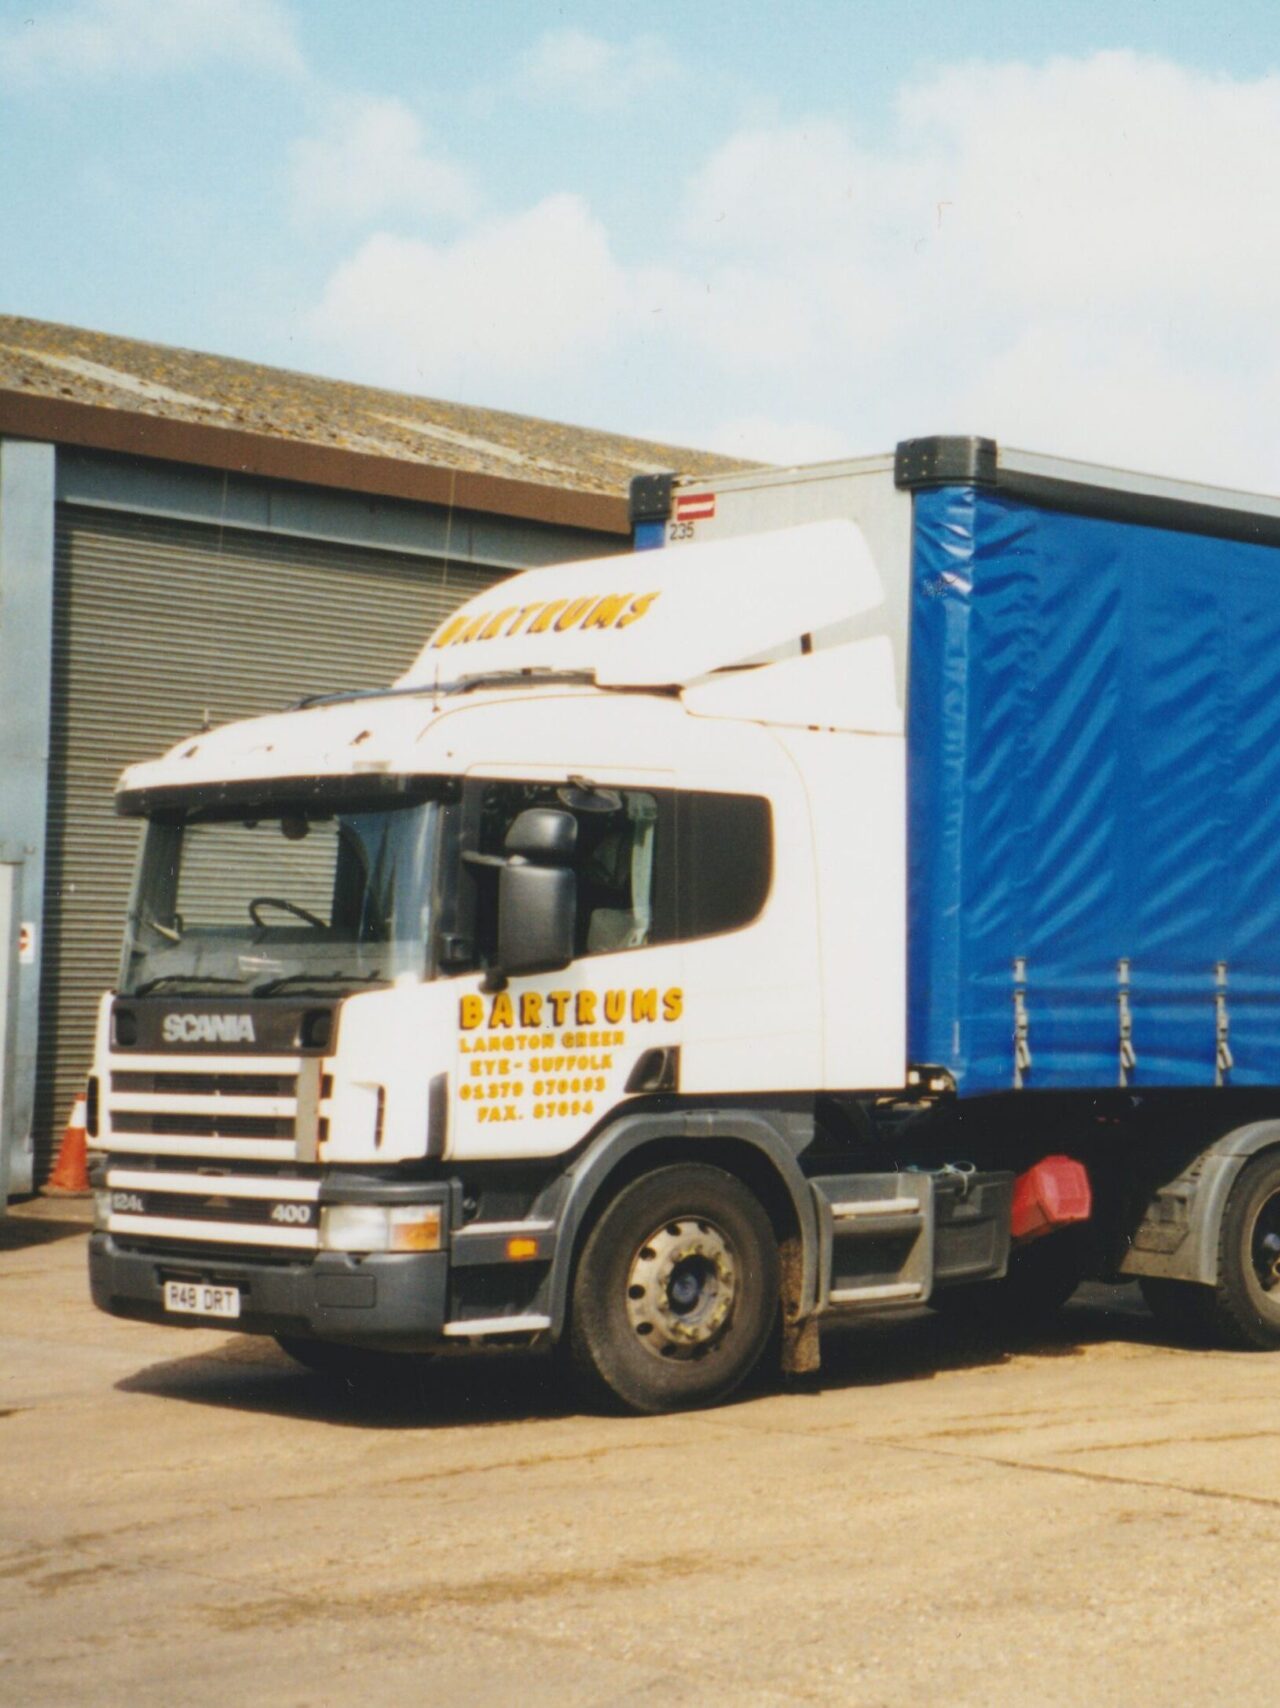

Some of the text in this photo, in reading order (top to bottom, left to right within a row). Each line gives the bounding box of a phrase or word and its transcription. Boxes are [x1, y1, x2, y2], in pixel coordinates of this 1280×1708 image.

[670, 521, 695, 541] 235
[430, 590, 662, 649] BARTRUMS
[459, 987, 684, 1030] BARTRUMS
[162, 1014, 255, 1043] SCANIA
[459, 1030, 625, 1053] LANGTON GREEN
[470, 1058, 510, 1076] EYE
[529, 1054, 612, 1073] SUFFOLK
[271, 1205, 310, 1223] 400
